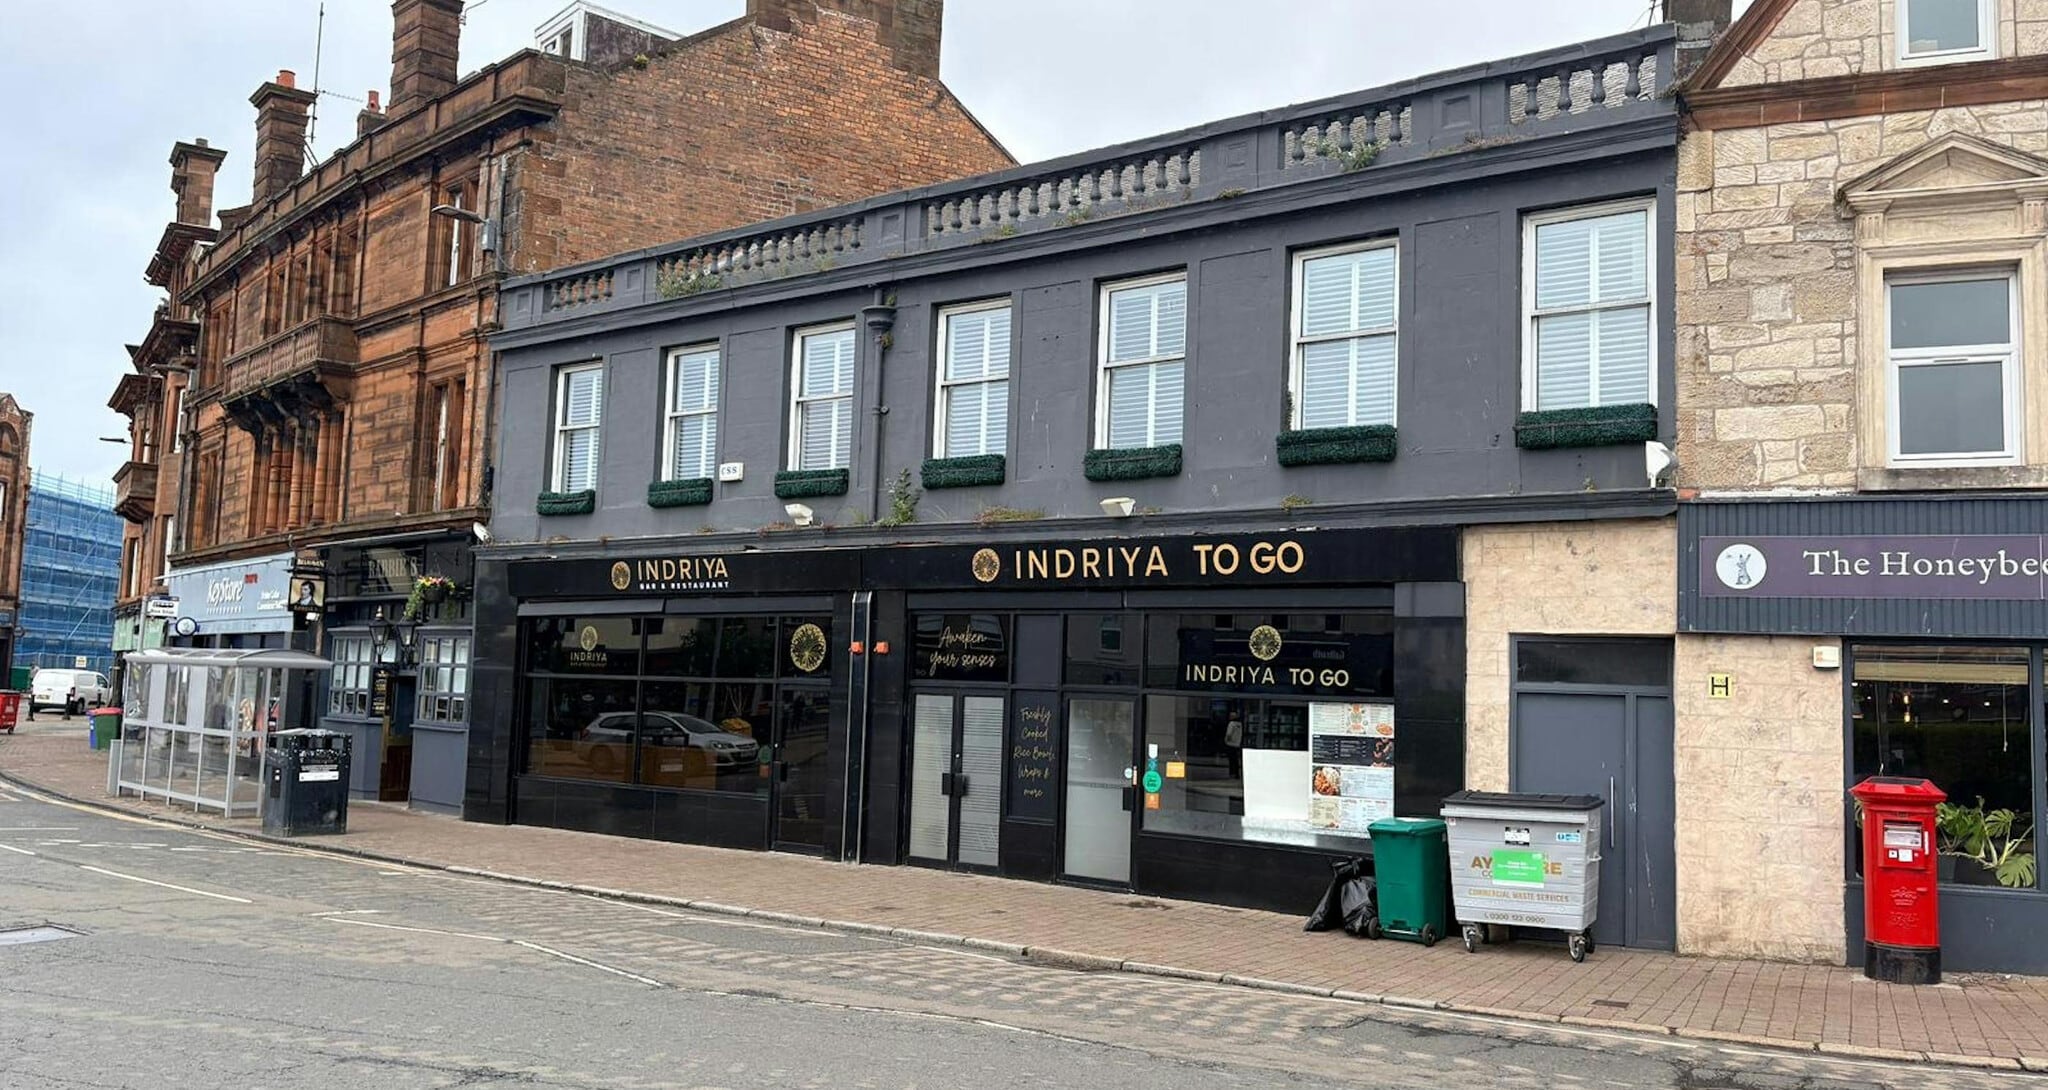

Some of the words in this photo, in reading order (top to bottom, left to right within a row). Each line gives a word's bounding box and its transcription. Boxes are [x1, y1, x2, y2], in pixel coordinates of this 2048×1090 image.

[637, 558, 729, 581] INDRIYA
[1015, 546, 1168, 579] INDRIYA
[1193, 543, 1240, 575] TO
[1249, 540, 1305, 574] GO
[1802, 549, 1870, 576] The
[206, 577, 244, 607] KeyStore
[639, 582, 656, 590] BAR
[670, 581, 729, 590] RESTAURANT
[938, 624, 984, 649] Awaken
[570, 651, 608, 662] INDRIYA
[929, 651, 960, 677] your
[961, 653, 996, 668] senses
[1186, 664, 1275, 684] INDRIYA
[1289, 668, 1315, 686] TO
[1319, 669, 1349, 687] GO
[1711, 676, 1729, 696] H
[1021, 727, 1049, 743] Cooked
[1468, 888, 1511, 899] COMMERCIAL
[1512, 891, 1536, 900] WASTE
[1537, 893, 1569, 903] SERVICES
